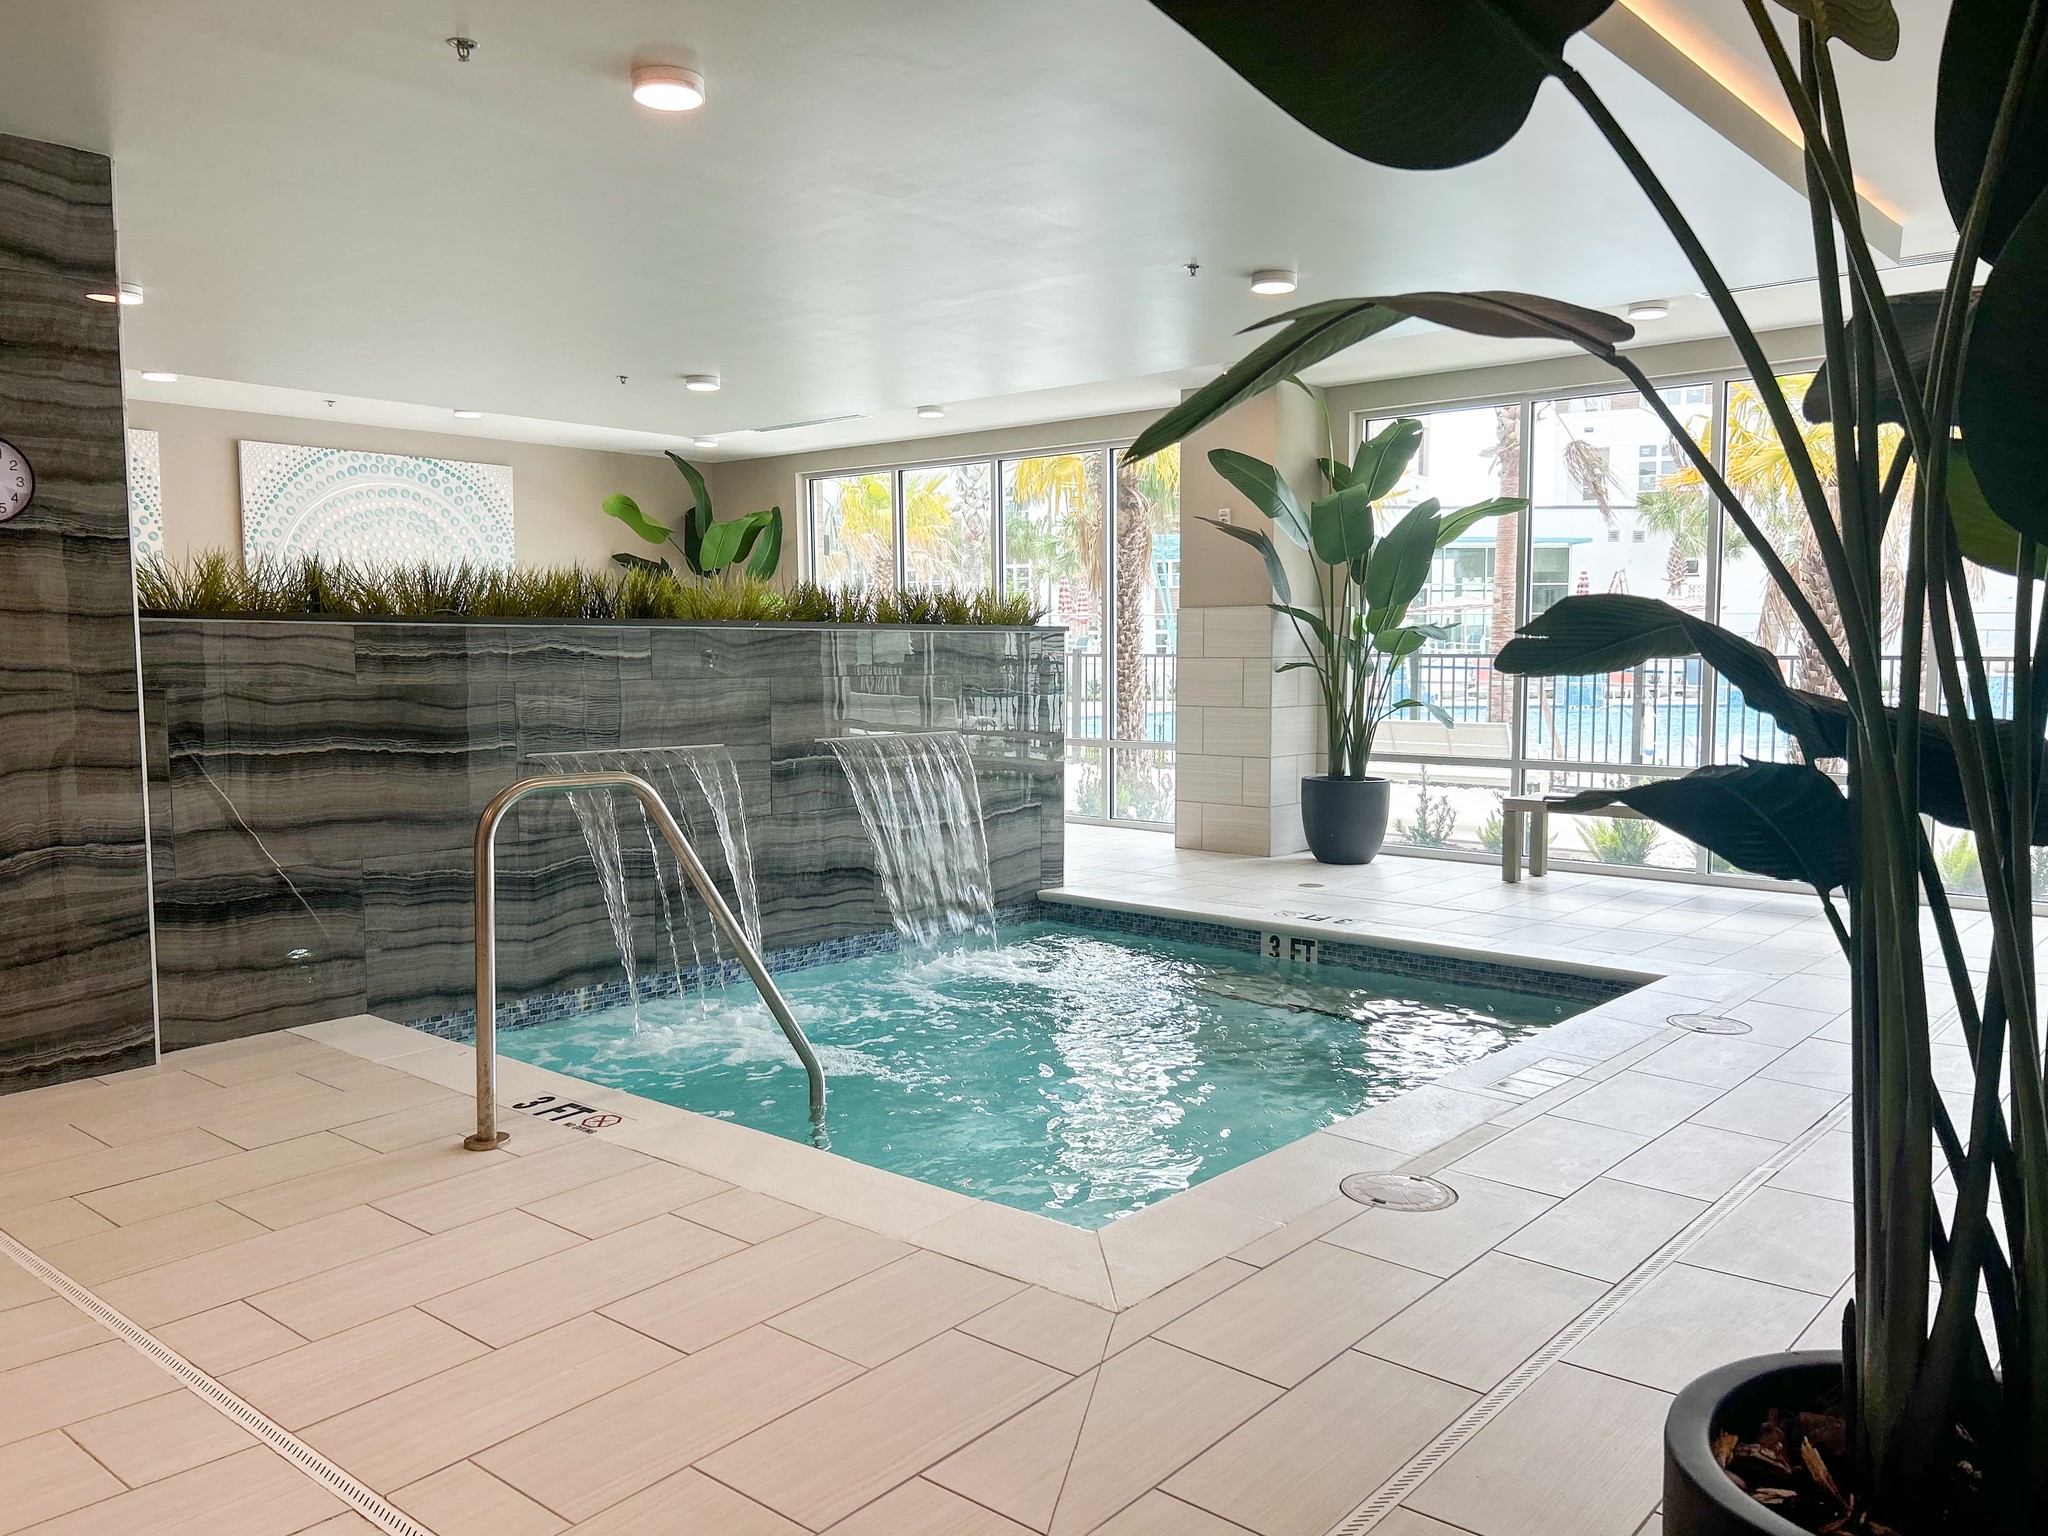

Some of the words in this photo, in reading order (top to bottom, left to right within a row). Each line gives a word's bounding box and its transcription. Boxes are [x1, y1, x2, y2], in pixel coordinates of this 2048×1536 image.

[9, 460, 18, 471] 2
[16, 476, 25, 488] 3
[10, 492, 20, 504] 4
[1268, 935, 1281, 958] 3
[1290, 937, 1316, 963] FT
[512, 1096, 556, 1109] 3
[532, 1102, 598, 1122] FT
